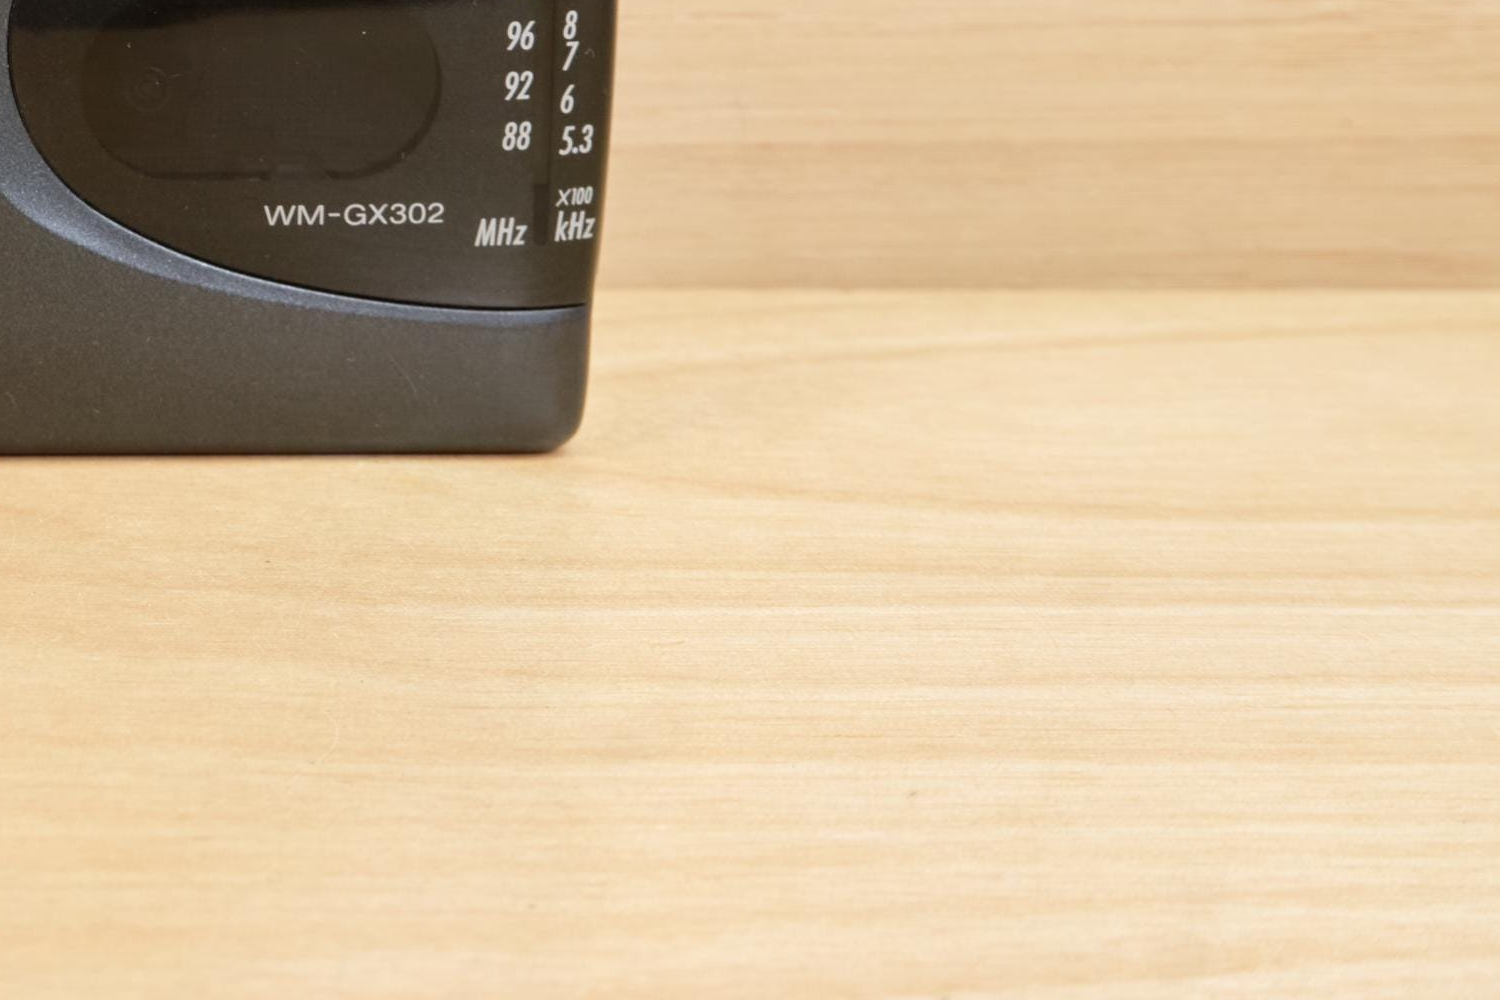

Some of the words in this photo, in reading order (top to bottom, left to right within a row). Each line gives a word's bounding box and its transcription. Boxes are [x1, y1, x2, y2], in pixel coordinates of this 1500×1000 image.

[506, 20, 536, 50] 96
[562, 10, 578, 40] 8
[562, 41, 579, 71] 7
[505, 70, 534, 100] 92
[560, 84, 575, 114] 6
[502, 121, 532, 151] 88
[559, 124, 594, 155] 5.3
[263, 202, 445, 226] WM-GX302
[554, 210, 596, 242] kHz
[474, 217, 528, 247] MHz
